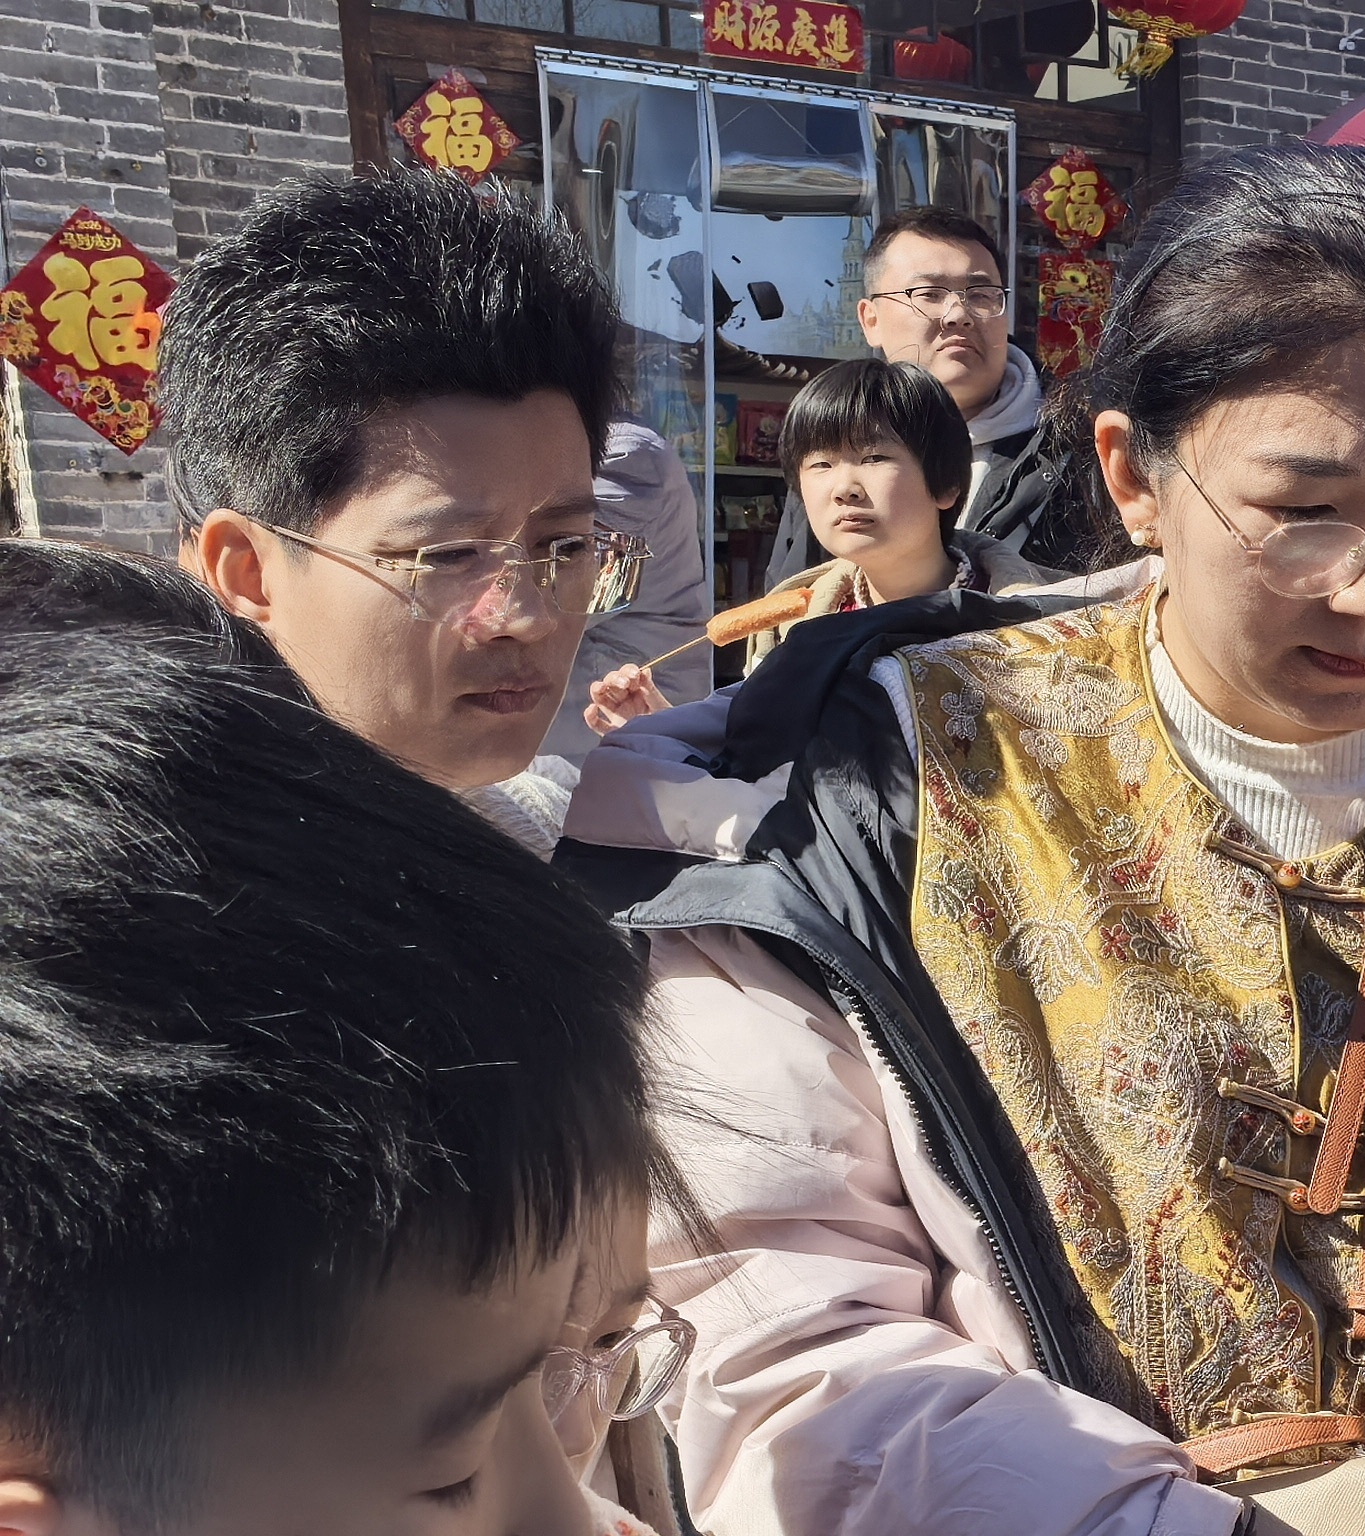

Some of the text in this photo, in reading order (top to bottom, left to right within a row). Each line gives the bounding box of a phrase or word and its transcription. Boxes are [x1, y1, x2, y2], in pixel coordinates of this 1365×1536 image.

[420, 90, 493, 175] 福
[1043, 165, 1106, 238] 福
[41, 252, 162, 371] 福
